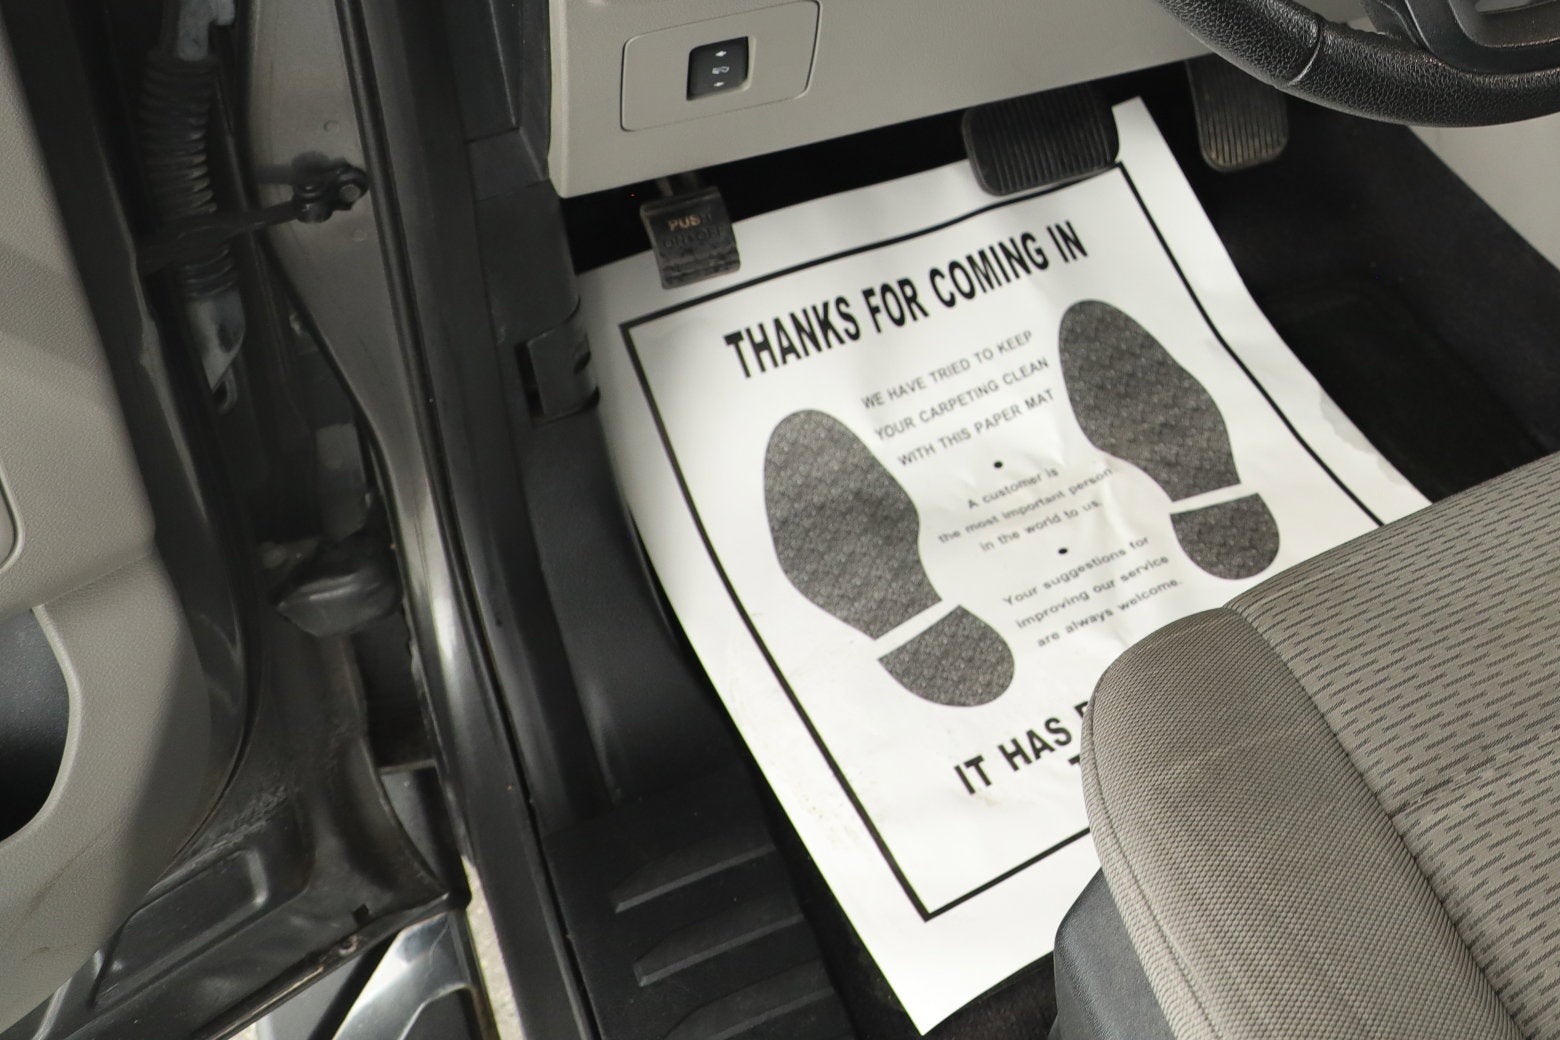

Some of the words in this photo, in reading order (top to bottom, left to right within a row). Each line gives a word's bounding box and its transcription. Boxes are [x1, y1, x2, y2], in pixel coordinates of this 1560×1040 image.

[723, 296, 861, 378] THANKS
[861, 277, 929, 334] FOR
[929, 232, 1049, 308] COMING
[1046, 220, 1089, 263] IN
[861, 391, 885, 409] WE
[887, 376, 926, 401] HAVE
[929, 358, 971, 383] TRIED
[974, 347, 994, 364] TO
[996, 330, 1032, 354] KEEP
[874, 416, 916, 440] YOUR
[919, 379, 999, 423] CARPETING
[1002, 357, 1050, 385] CLEAN
[897, 443, 936, 467] WITH
[939, 427, 971, 449] THIS
[973, 403, 1022, 435] PAPER
[1024, 388, 1055, 411] MAT
[937, 529, 961, 544] the
[965, 515, 999, 533] most
[1001, 490, 1065, 520] important
[1068, 467, 1113, 496] person
[968, 499, 979, 509] A
[982, 474, 1043, 504] customer
[1045, 467, 1059, 478] is
[979, 540, 995, 552] in
[998, 531, 1020, 545] the
[1024, 513, 1062, 534] world
[1064, 508, 1079, 520] to
[1002, 586, 1038, 606] Your
[1043, 548, 1127, 590] suggestions
[1129, 536, 1150, 550] for
[1016, 589, 1090, 629] improving
[1092, 580, 1117, 594] our
[1120, 555, 1169, 583] service
[1037, 631, 1060, 647] are
[1065, 609, 1114, 635] always
[1117, 577, 1183, 611] welcome.
[954, 755, 992, 795] IT
[997, 717, 1072, 772] HAS
